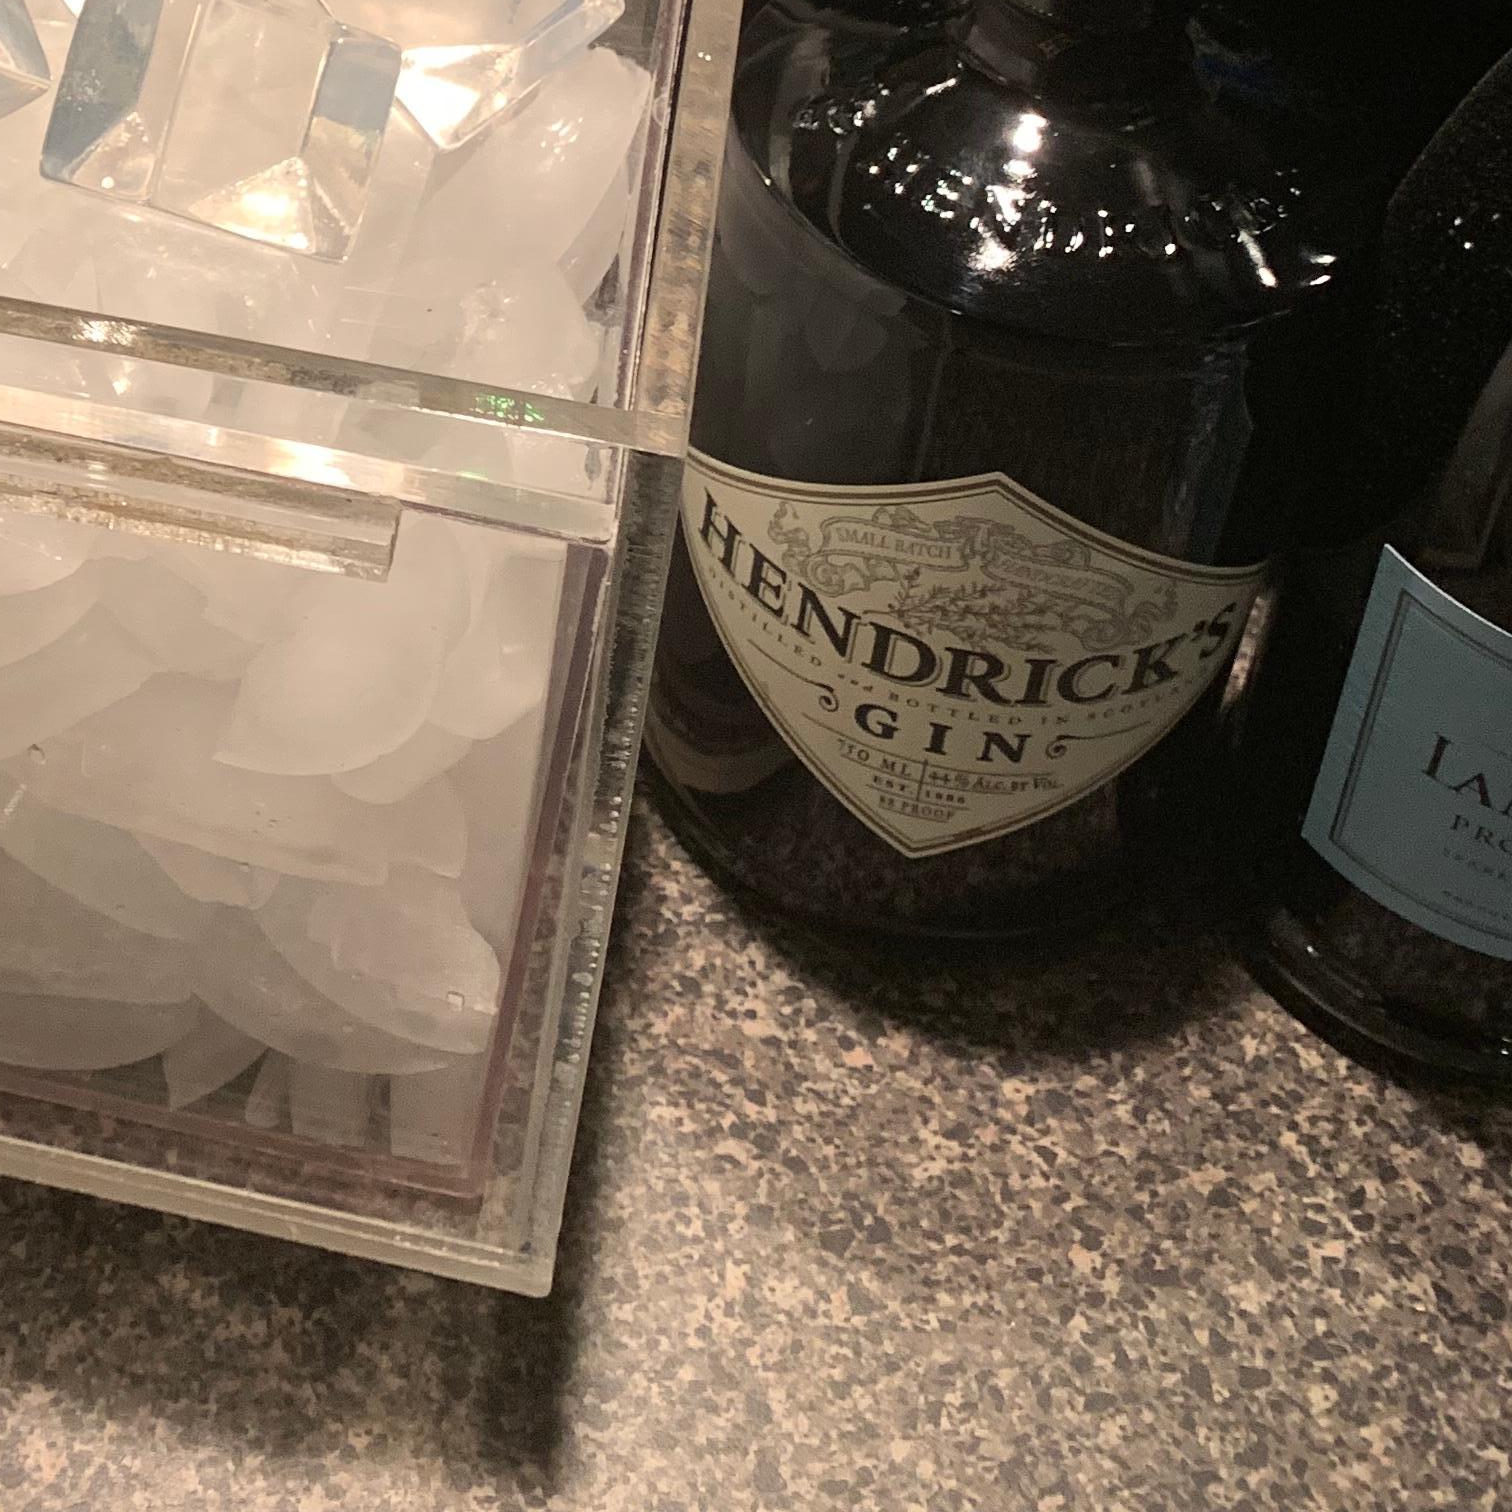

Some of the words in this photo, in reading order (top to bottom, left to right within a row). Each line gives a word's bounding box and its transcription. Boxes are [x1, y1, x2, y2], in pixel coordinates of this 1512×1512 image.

[698, 486, 1238, 709] HENDRICK'S
[853, 701, 1032, 764] GIN
[879, 757, 913, 779] ML
